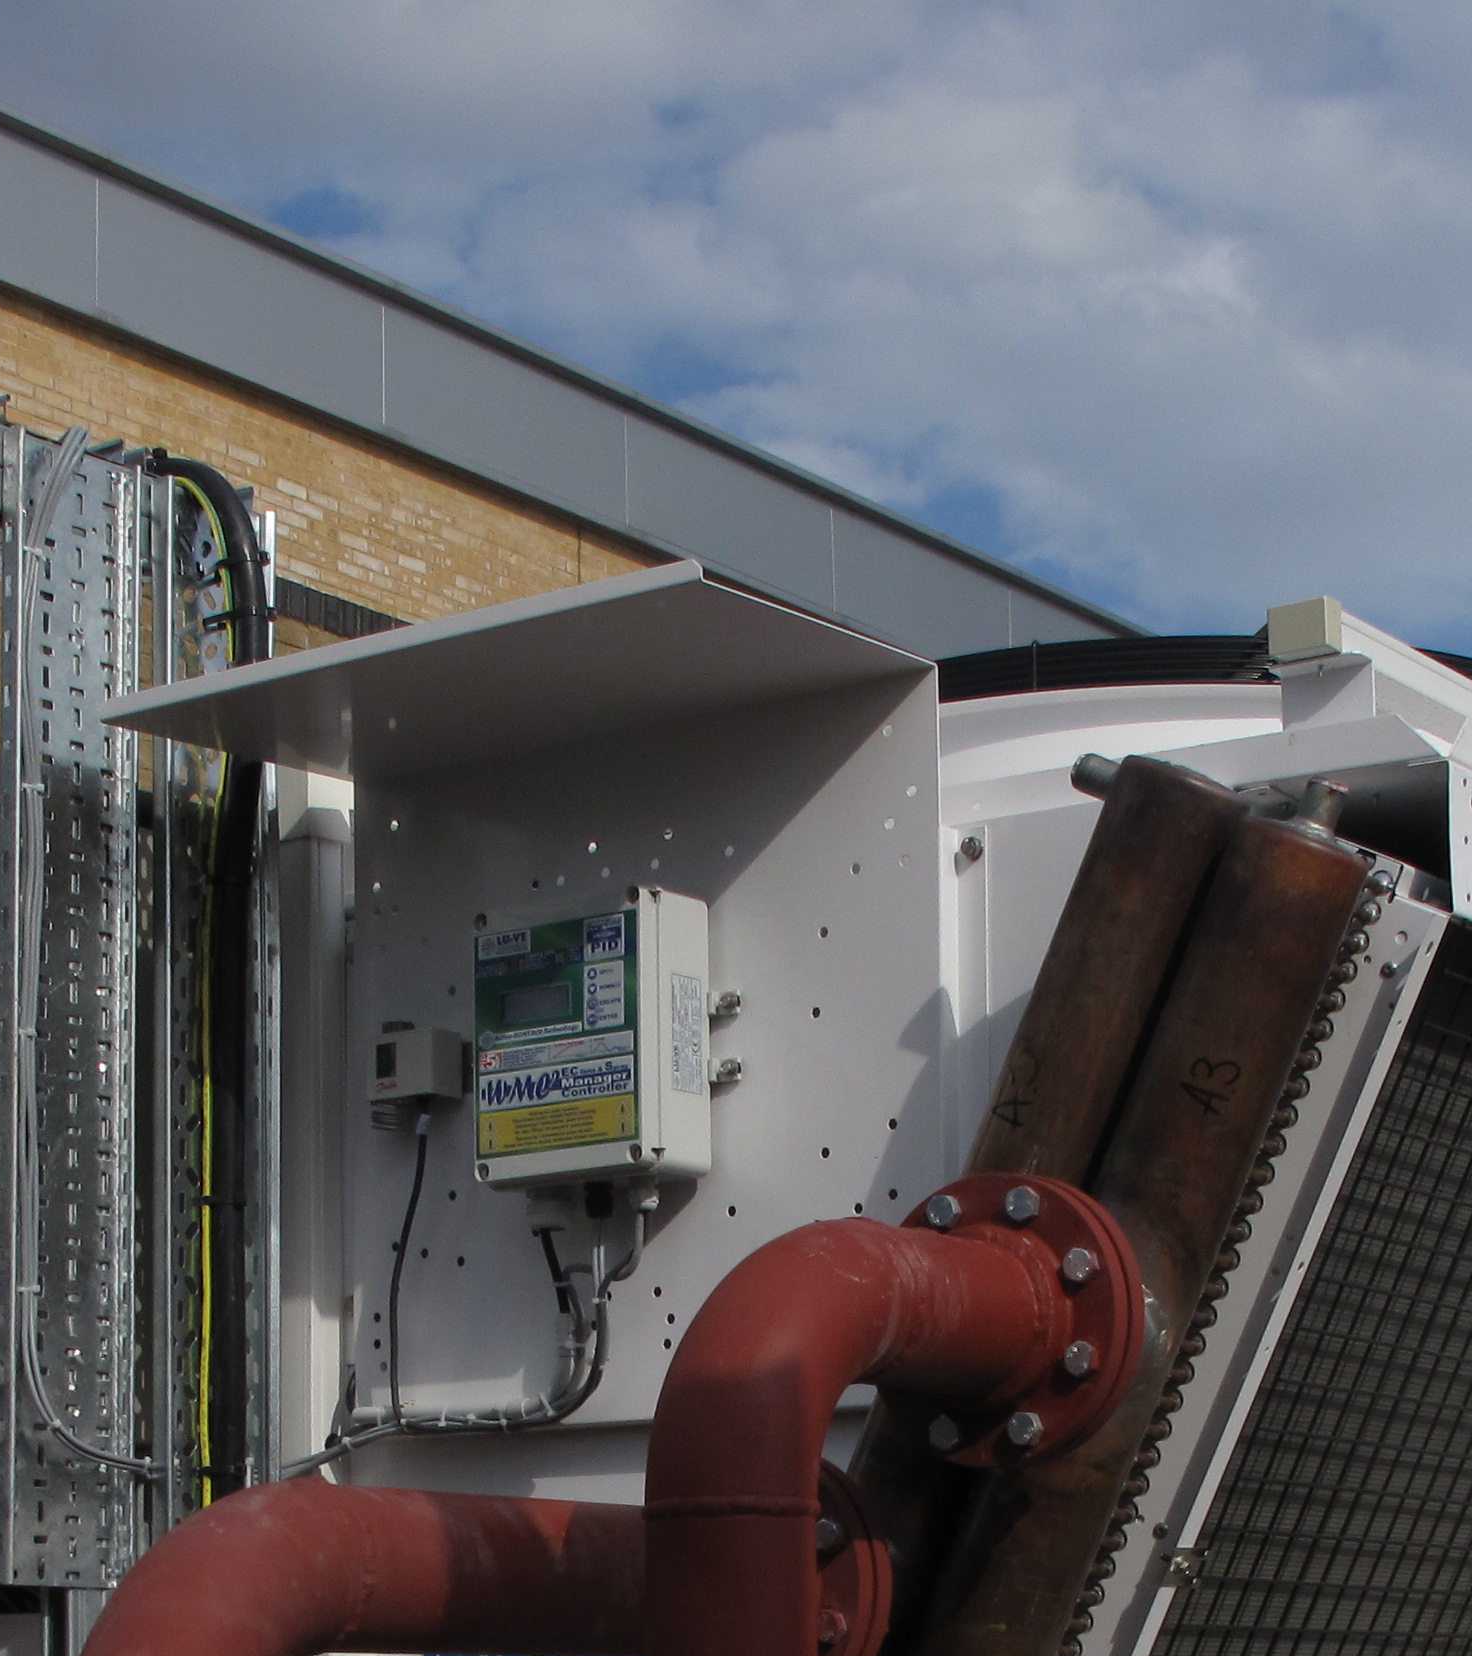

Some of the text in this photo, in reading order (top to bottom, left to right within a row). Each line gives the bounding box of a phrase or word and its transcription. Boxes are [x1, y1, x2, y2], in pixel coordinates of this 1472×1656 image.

[496, 932, 527, 946] LU-VE
[590, 940, 618, 953] PID
[561, 1066, 578, 1078] EC
[561, 1070, 629, 1089] Manager
[561, 1080, 629, 1098] Controller
